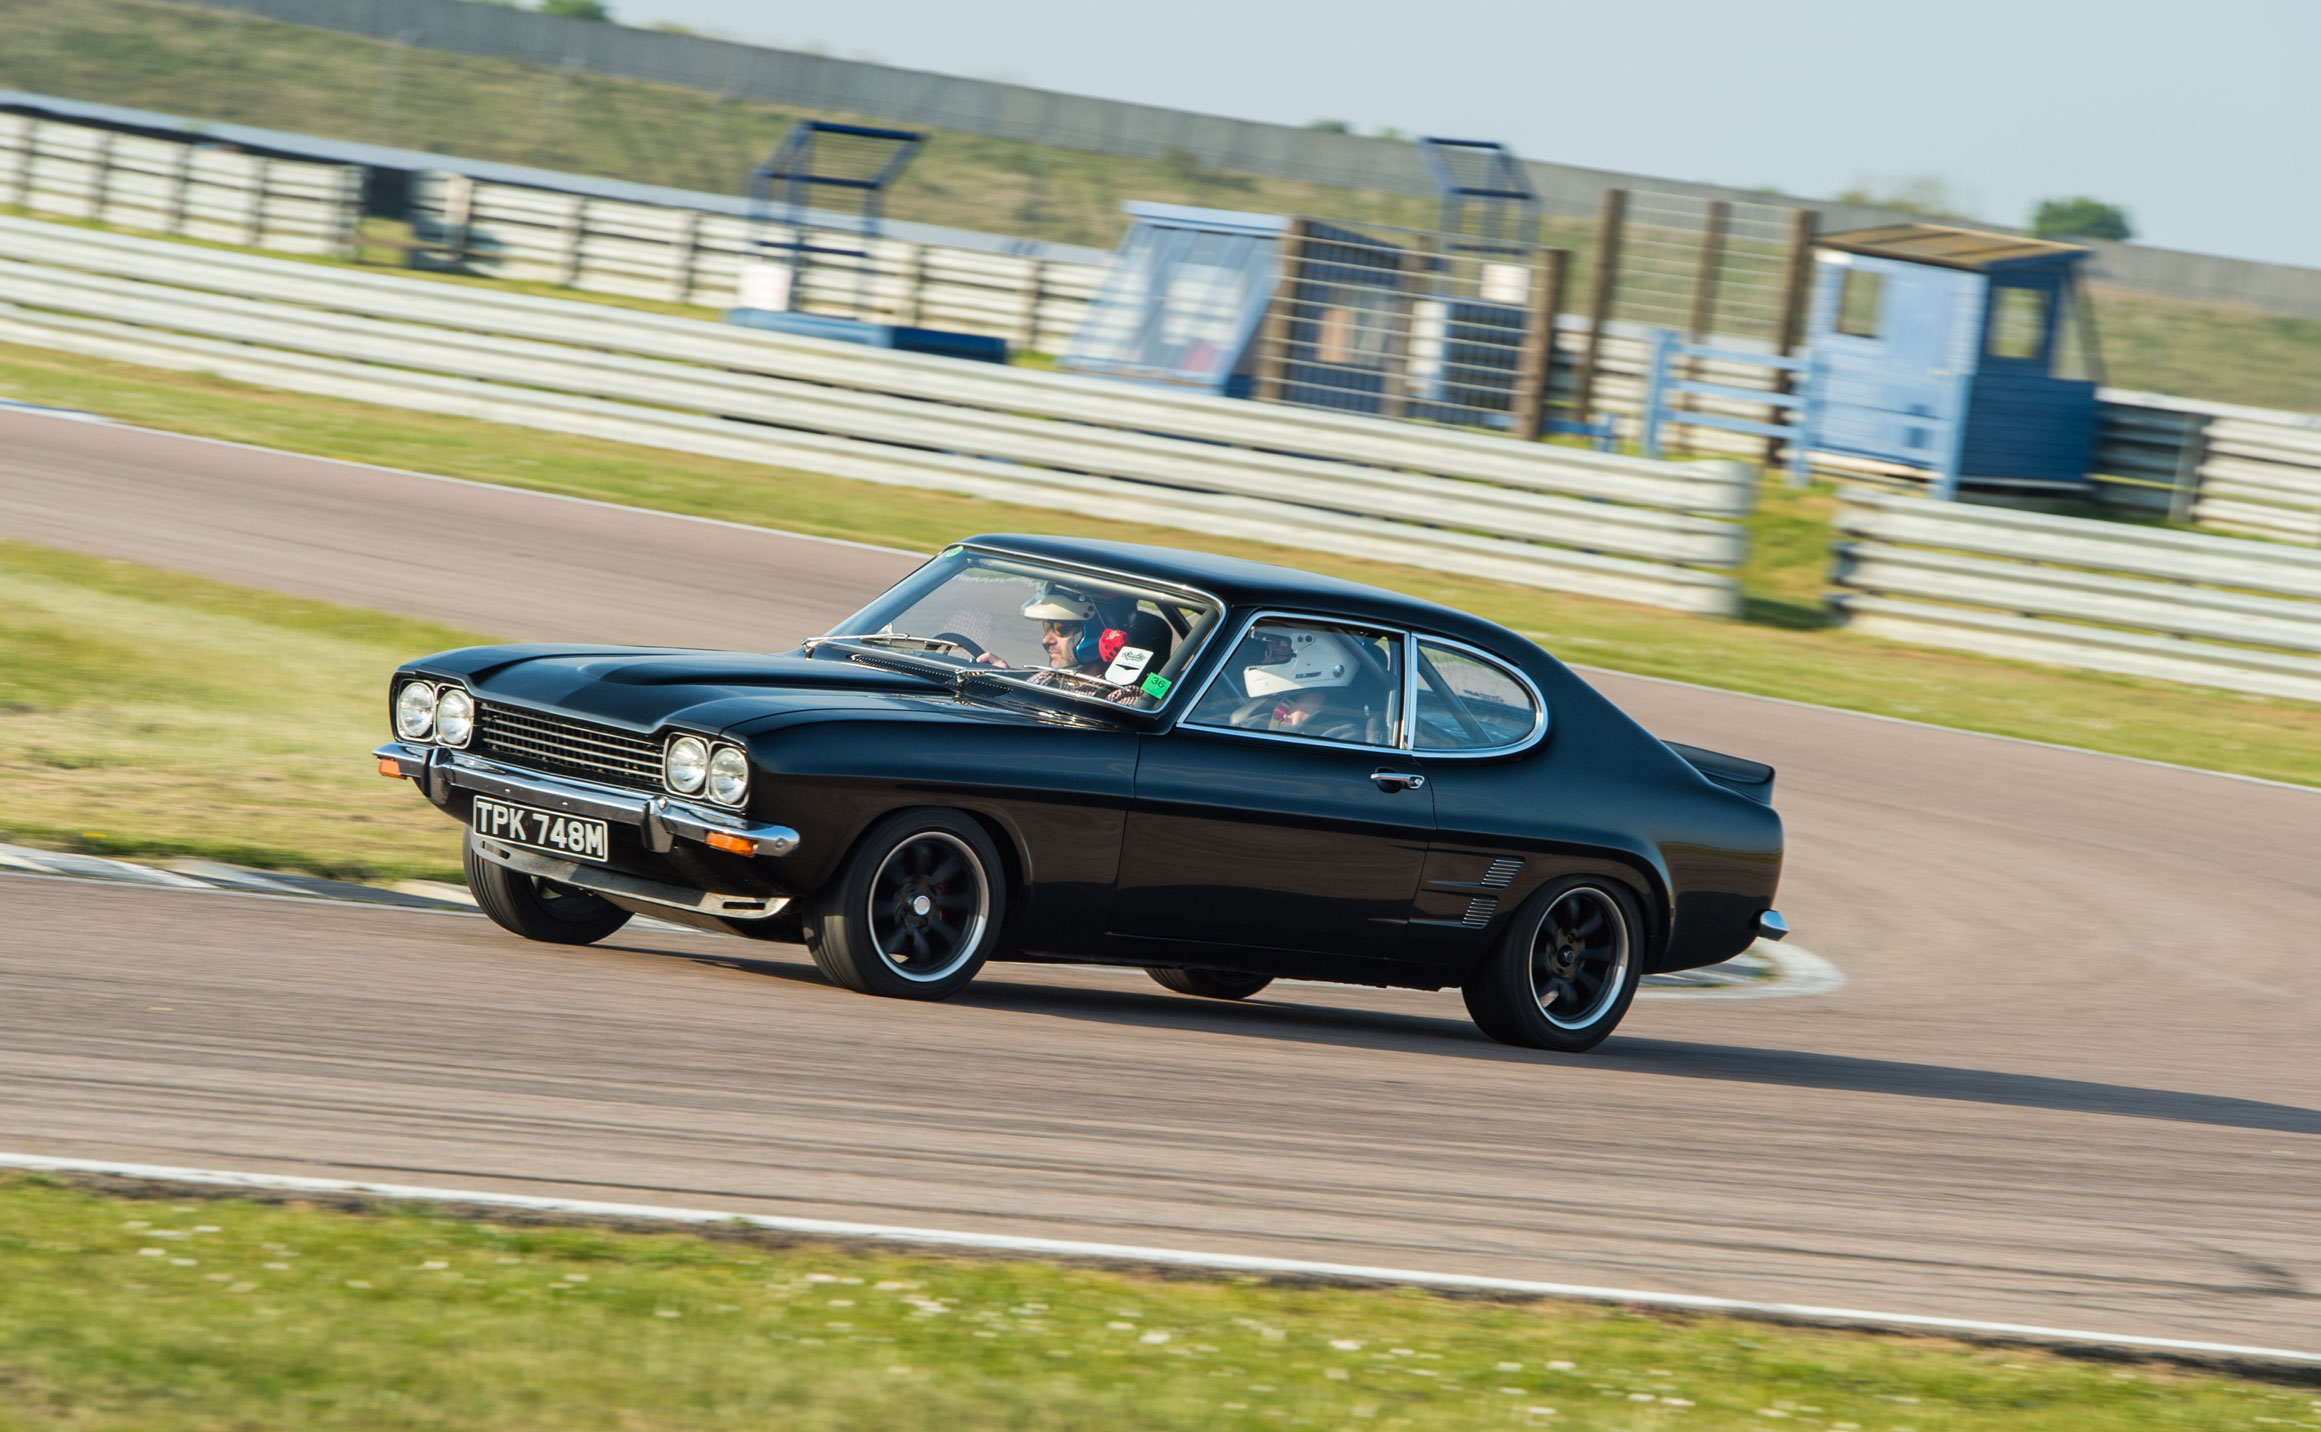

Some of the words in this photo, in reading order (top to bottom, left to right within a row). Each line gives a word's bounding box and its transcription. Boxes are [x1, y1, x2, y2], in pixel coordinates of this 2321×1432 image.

[1151, 676, 1166, 688] 36
[476, 800, 527, 841] TPK
[532, 812, 604, 857] 748M
